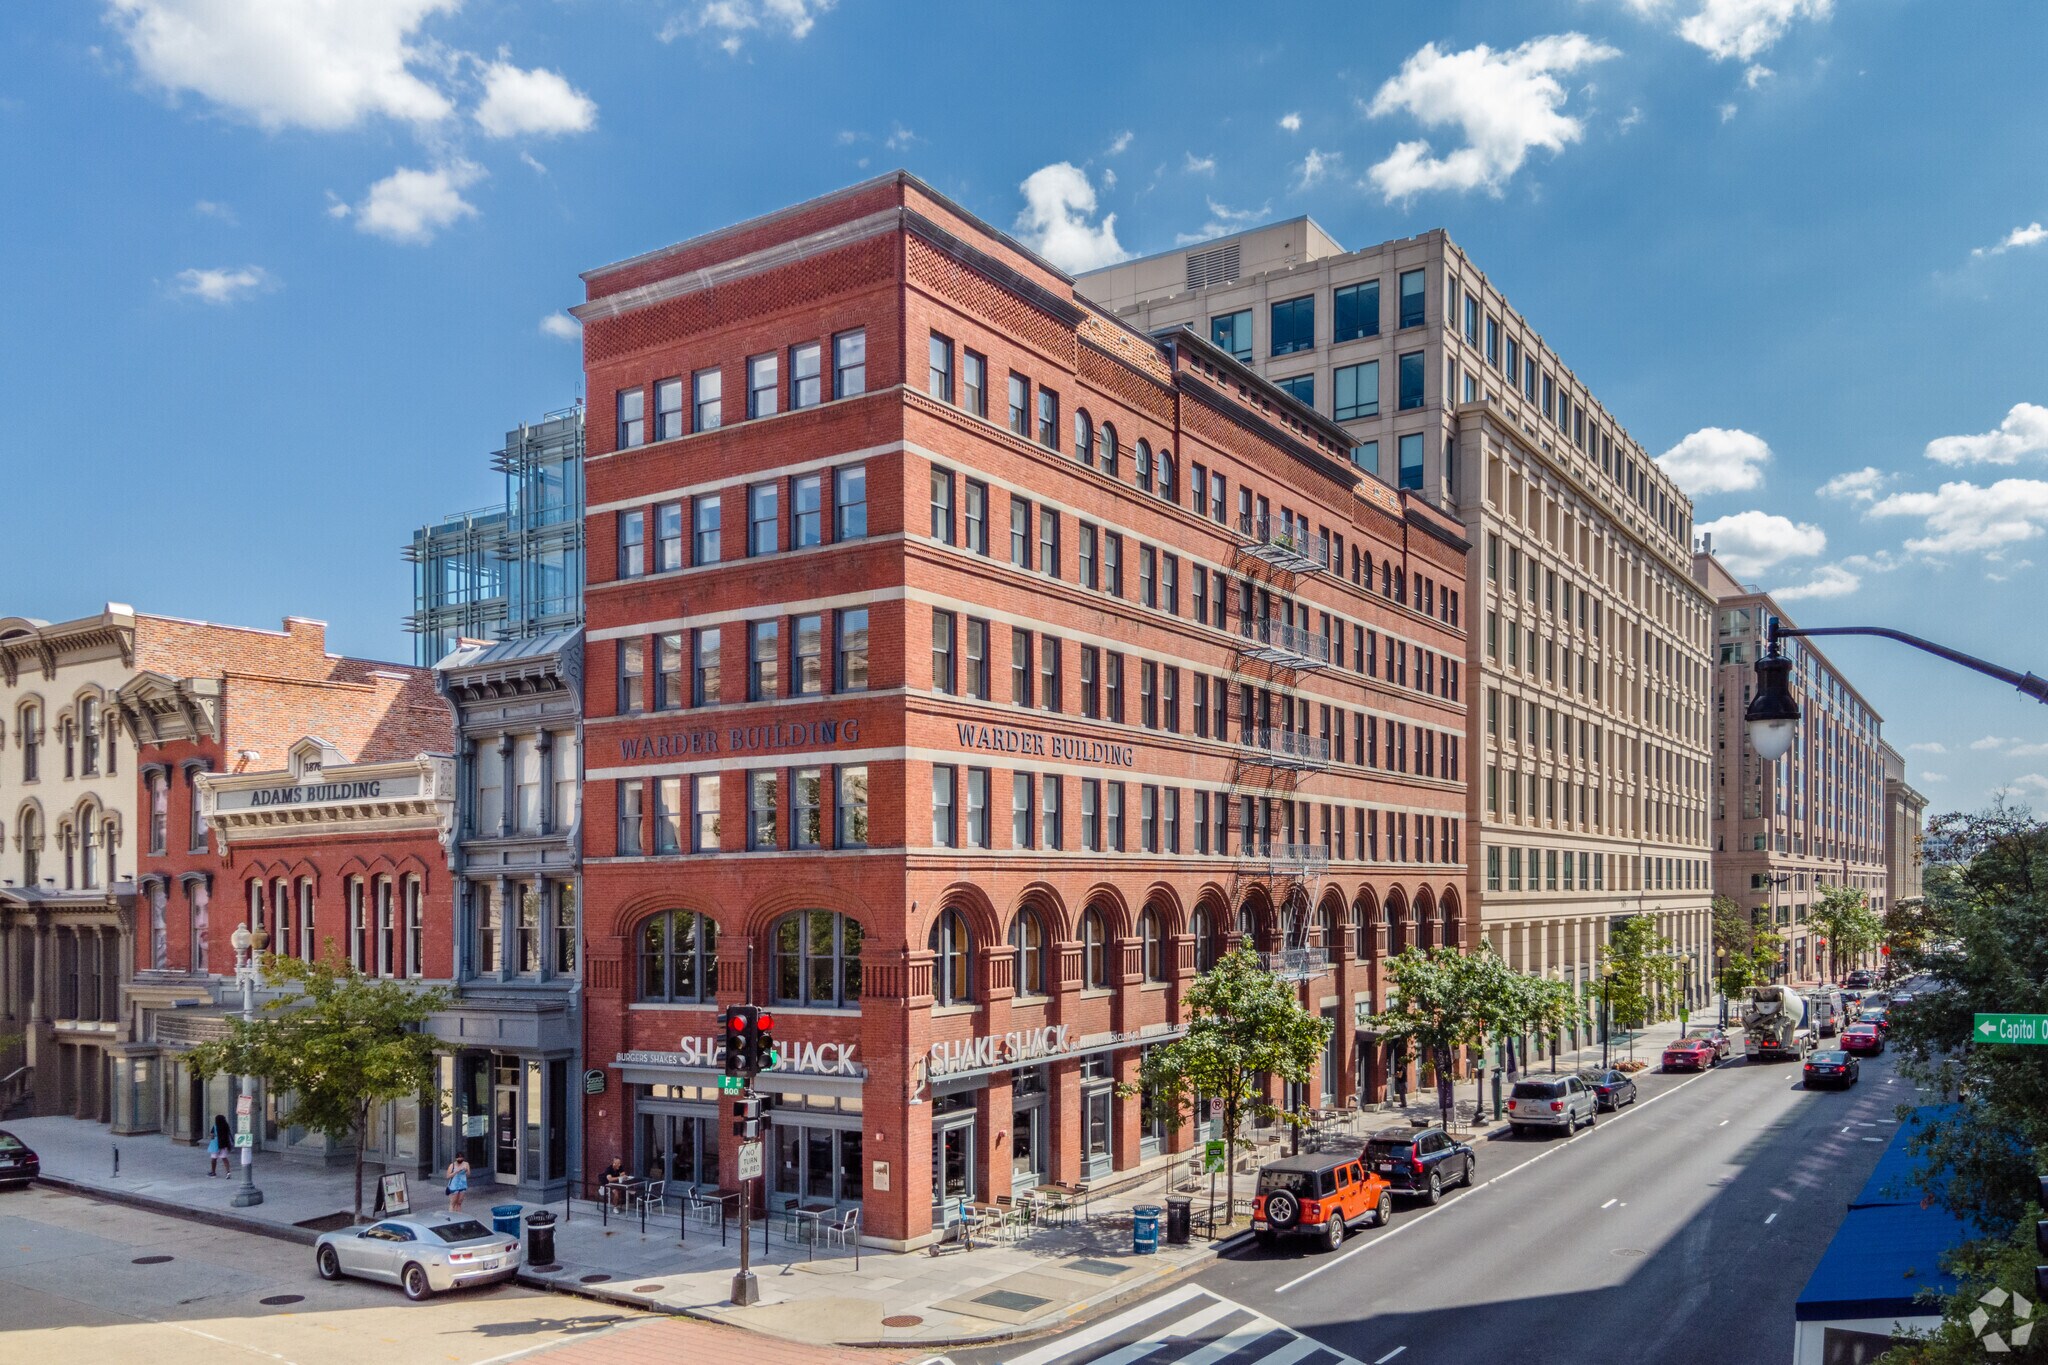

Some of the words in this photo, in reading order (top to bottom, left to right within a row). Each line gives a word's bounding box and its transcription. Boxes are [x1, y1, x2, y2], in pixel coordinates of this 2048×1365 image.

[619, 730, 719, 760] WARDER
[728, 719, 859, 751] BUILDING
[957, 722, 1045, 756] WARDER
[1051, 734, 1134, 767] BUILDING
[250, 786, 302, 806] ADAMS
[306, 780, 381, 802] BUILDING
[1999, 1018, 2036, 1044] Capitol
[930, 1034, 1004, 1076] SHAKE
[1004, 1023, 1070, 1062] SHACK
[616, 1052, 648, 1063] BURGERS
[650, 1054, 678, 1064] SHAKES
[725, 1076, 731, 1087] F
[724, 1087, 739, 1096] 800
[745, 1148, 755, 1157] NO
[743, 1156, 758, 1166] TURN
[740, 1166, 749, 1175] ON
[749, 1164, 760, 1174] RED
